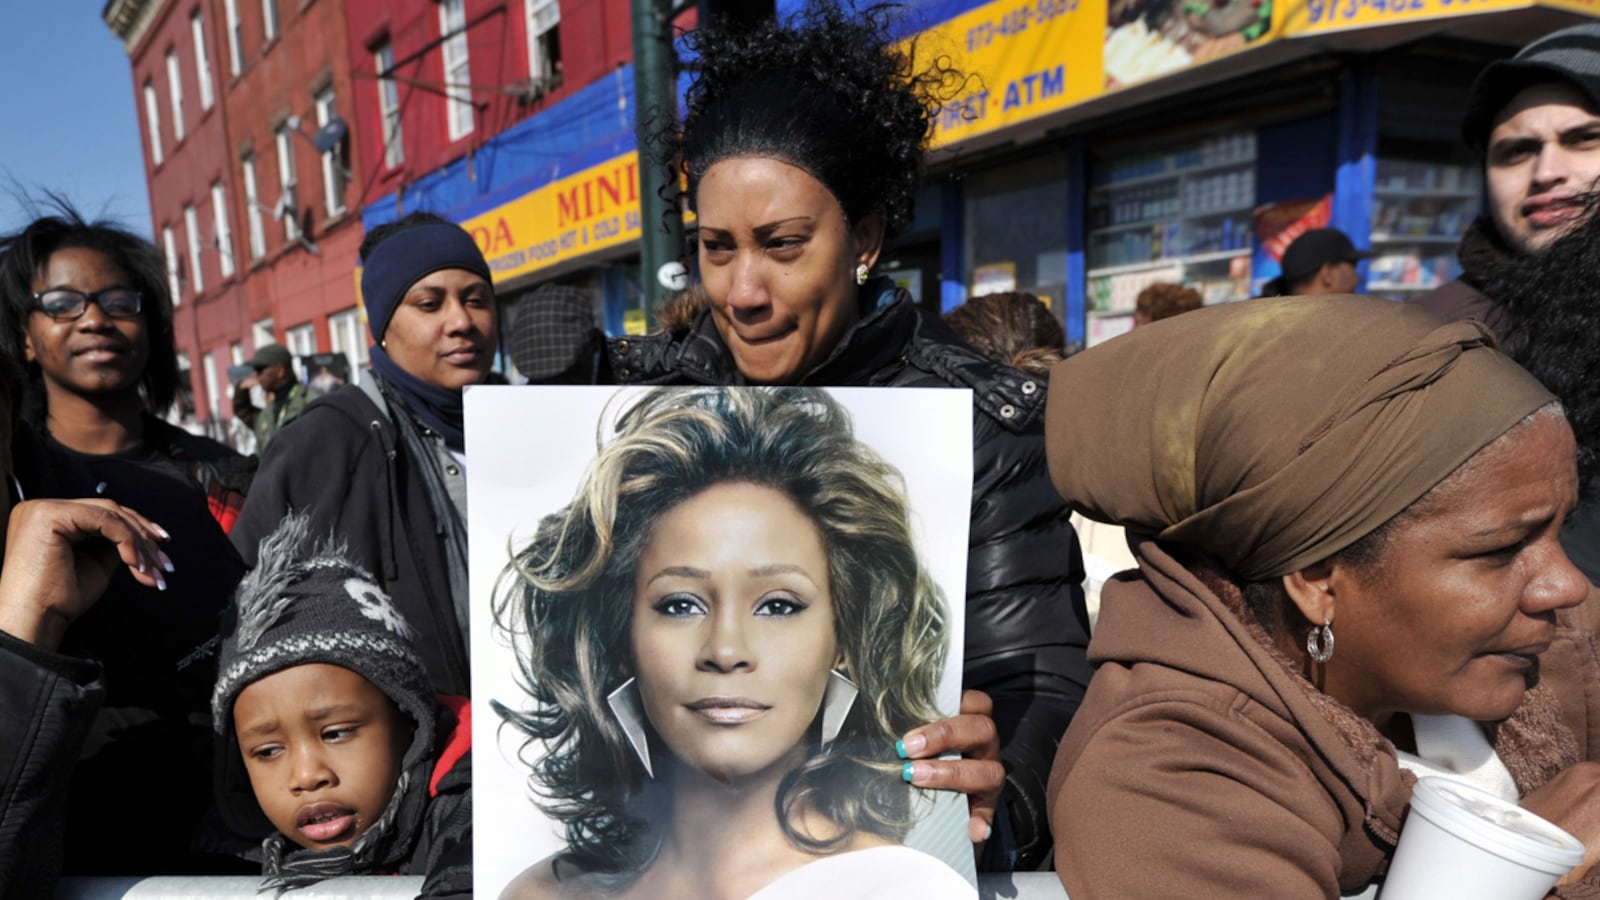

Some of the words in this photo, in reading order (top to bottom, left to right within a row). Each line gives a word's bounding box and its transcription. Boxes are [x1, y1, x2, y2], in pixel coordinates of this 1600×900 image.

[1002, 64, 1064, 112] ATM
[557, 163, 640, 228] MINI
[530, 239, 558, 264] FOOD
[561, 231, 579, 250] HOT
[582, 225, 589, 245] &
[595, 217, 621, 241] COLD
